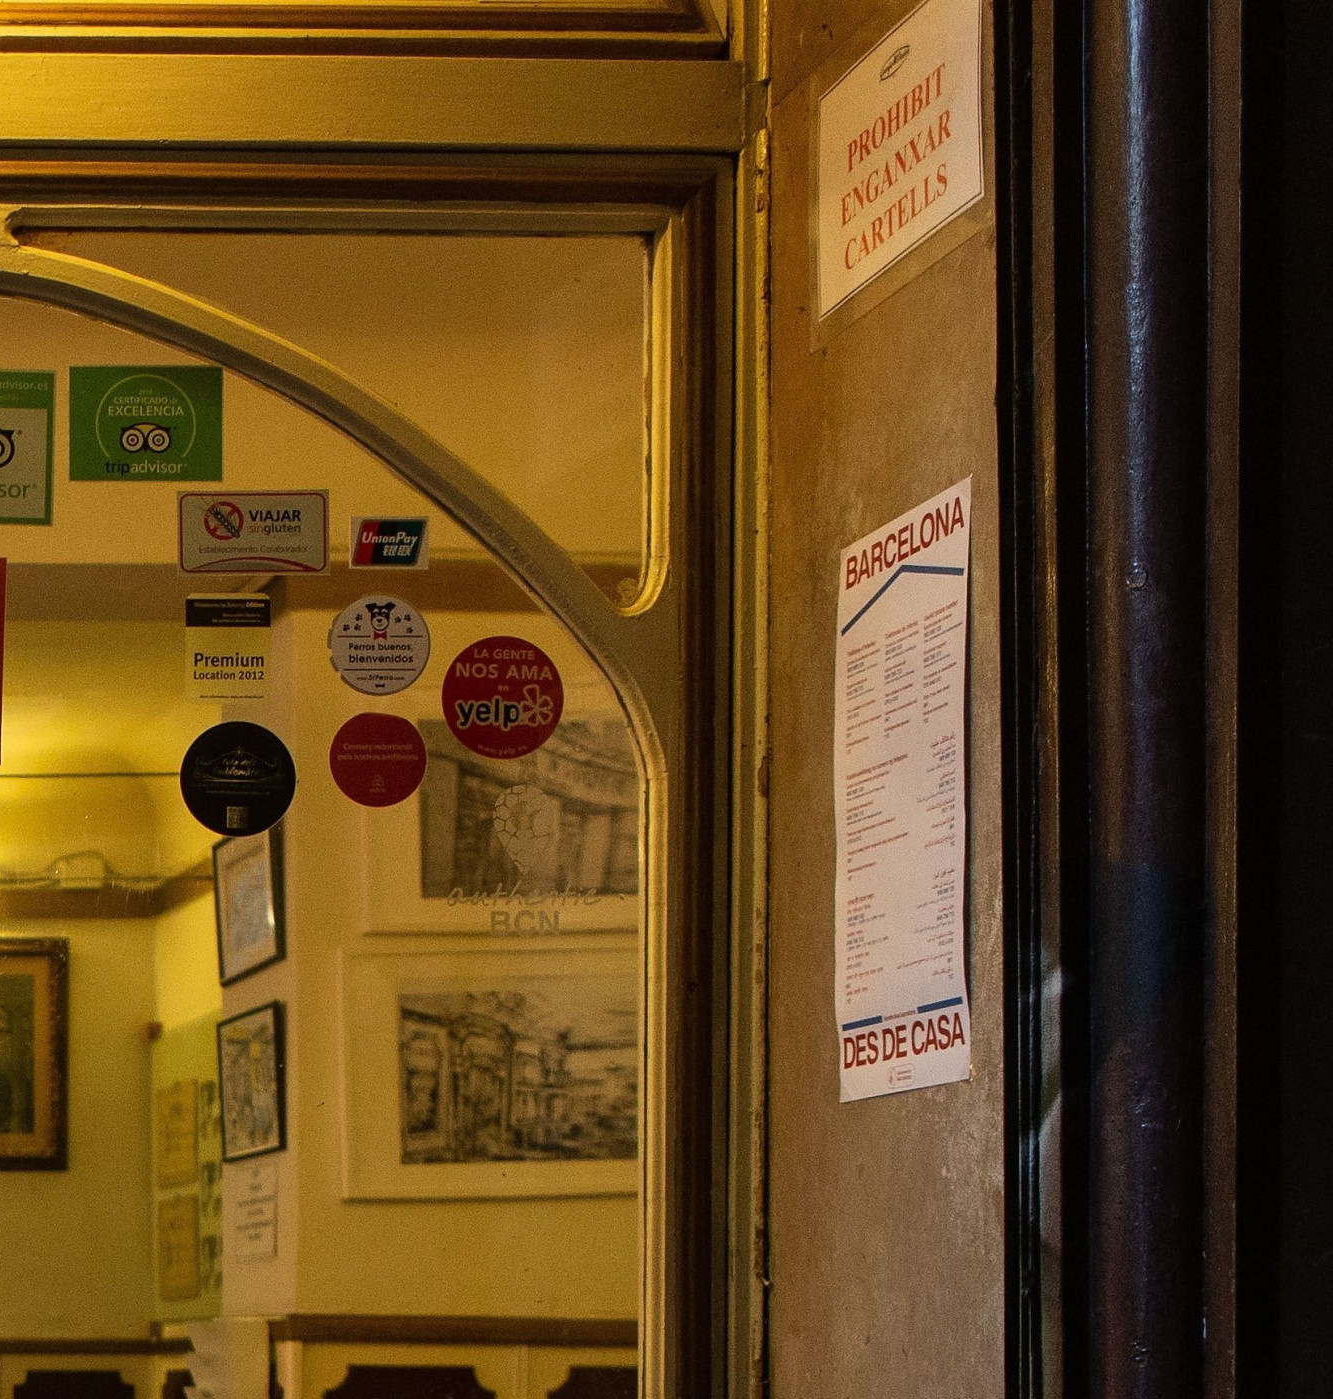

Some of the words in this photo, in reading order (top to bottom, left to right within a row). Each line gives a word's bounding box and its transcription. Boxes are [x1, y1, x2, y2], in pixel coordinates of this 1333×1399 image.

[846, 63, 945, 173] PROHIBIT
[841, 110, 951, 227] ENGANXAR
[844, 163, 948, 270] CARTELLS
[107, 405, 184, 417] EXCELENCIA
[105, 460, 183, 476] tripadvisor
[249, 509, 301, 522] VIAJAR
[362, 532, 418, 549] UnionPay
[845, 496, 965, 590] BARCELONA
[193, 652, 265, 667] Premium
[348, 653, 414, 664] bienvenidos
[474, 649, 489, 659] LA
[493, 649, 535, 660] GENTE
[193, 671, 235, 681] Location
[238, 671, 264, 681] 2012
[456, 663, 498, 678] NOS
[506, 664, 553, 681] AMA
[456, 697, 521, 731] yelp
[490, 910, 561, 937] BCN
[843, 1030, 880, 1069] DES
[882, 1024, 908, 1062] DE
[911, 1012, 965, 1056] CASA
